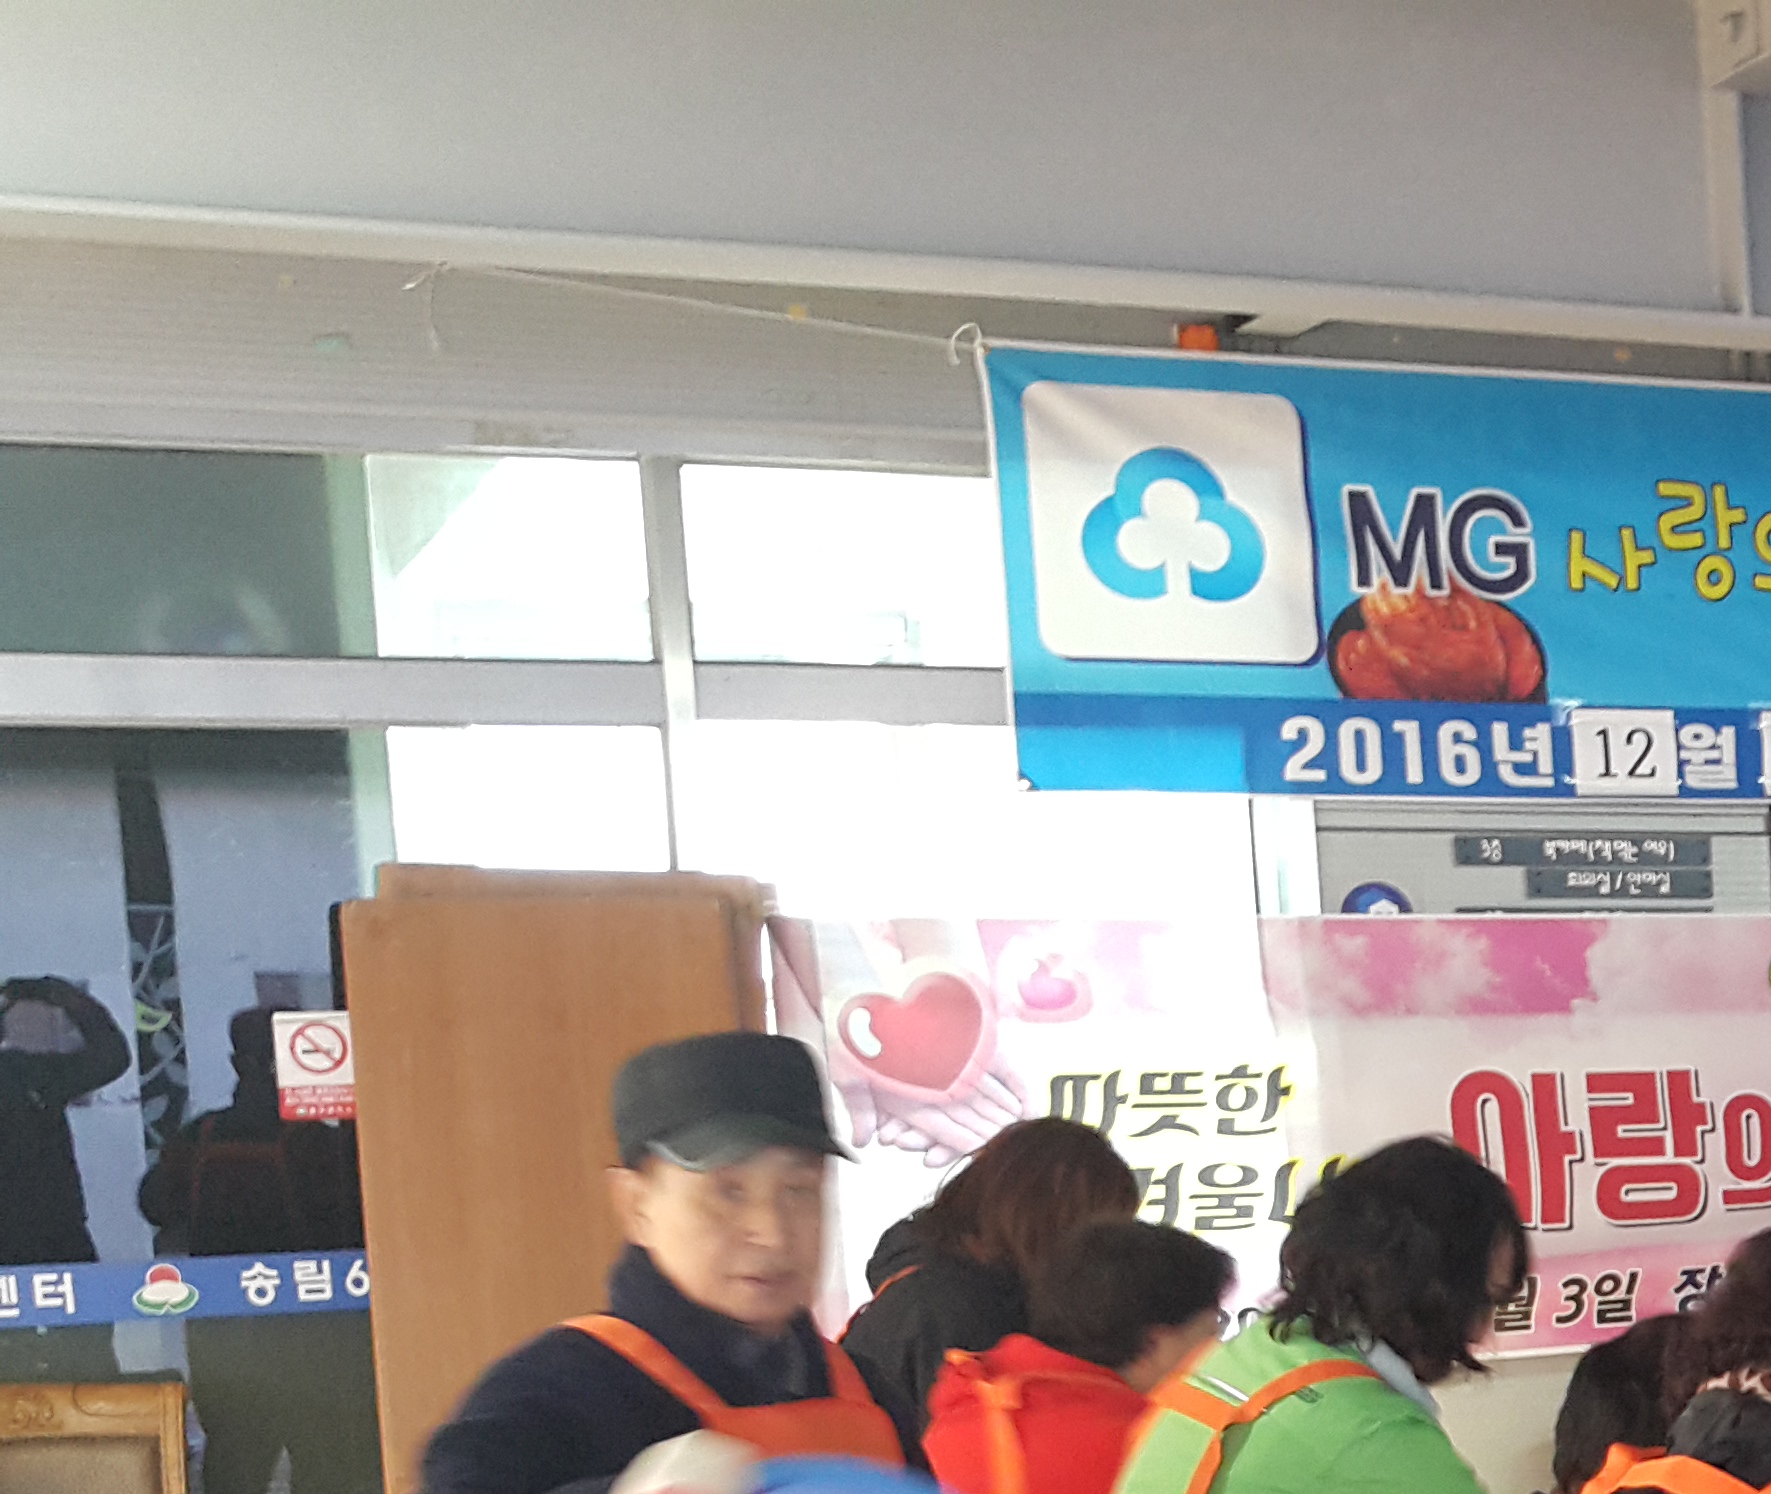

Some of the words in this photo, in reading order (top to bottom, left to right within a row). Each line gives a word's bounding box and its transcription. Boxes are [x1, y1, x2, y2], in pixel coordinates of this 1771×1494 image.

[1342, 485, 1534, 597] MG
[1280, 714, 1555, 788] 2016년
[1050, 1064, 1292, 1138] 따뜻한
[1554, 1268, 1641, 1327] 3일
